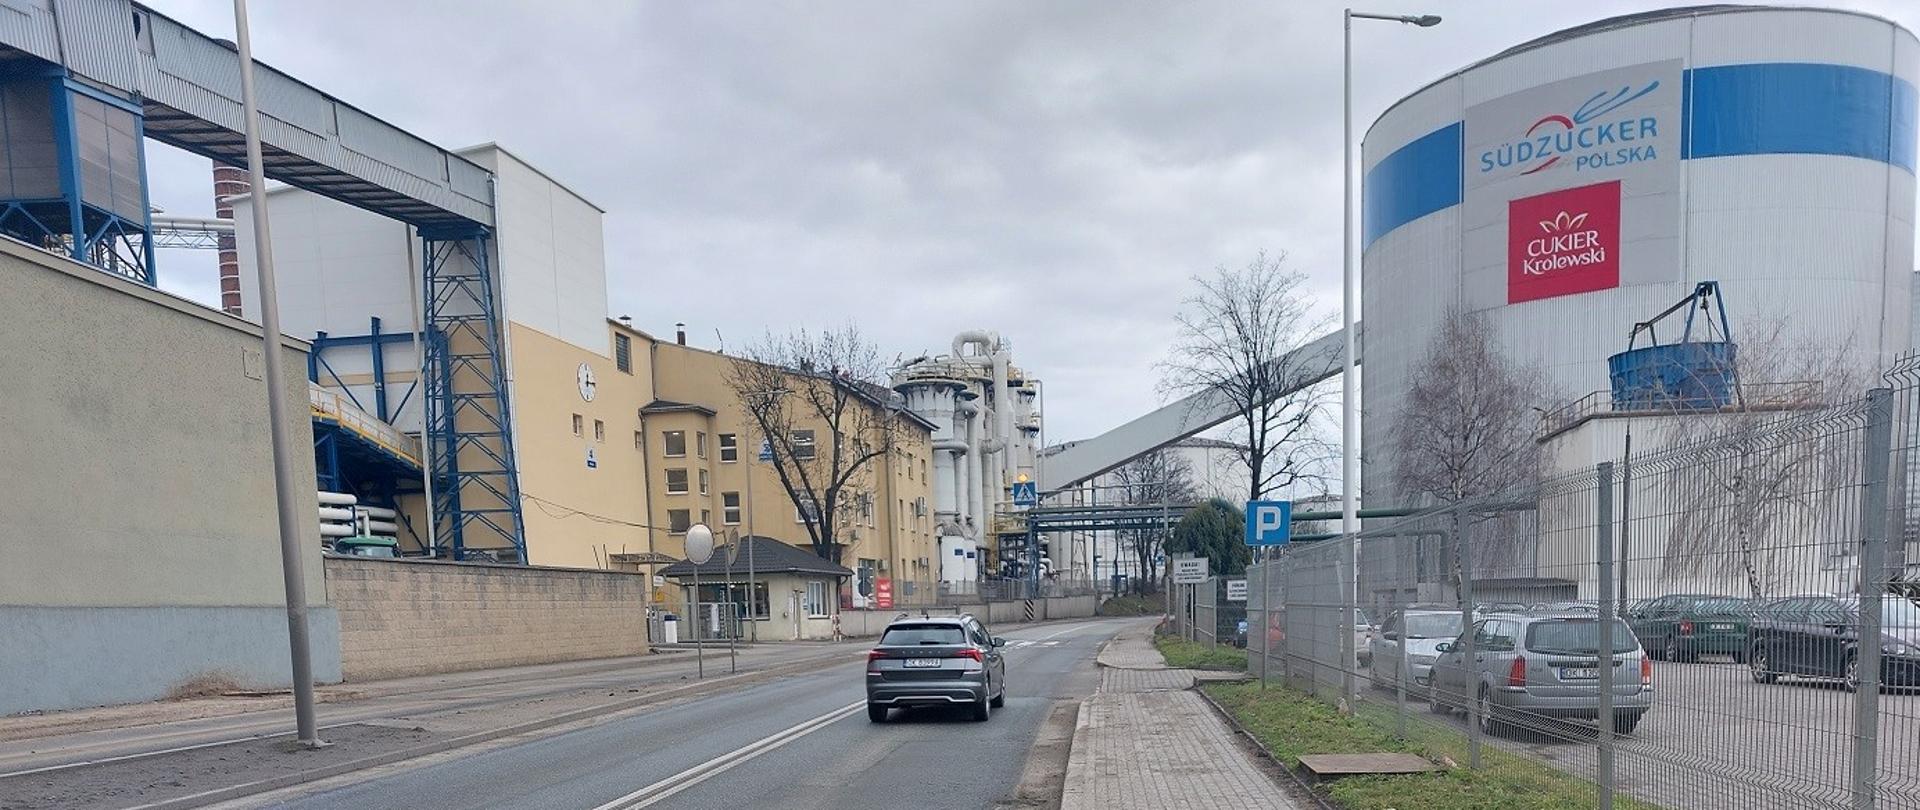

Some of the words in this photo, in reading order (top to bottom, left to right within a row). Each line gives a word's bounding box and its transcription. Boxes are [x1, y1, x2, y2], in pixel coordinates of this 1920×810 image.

[1481, 117, 1657, 172] SÜDZUCKER
[1576, 145, 1657, 171] POLSKA
[1528, 230, 1599, 257] CUKIER
[1257, 506, 1281, 540] P
